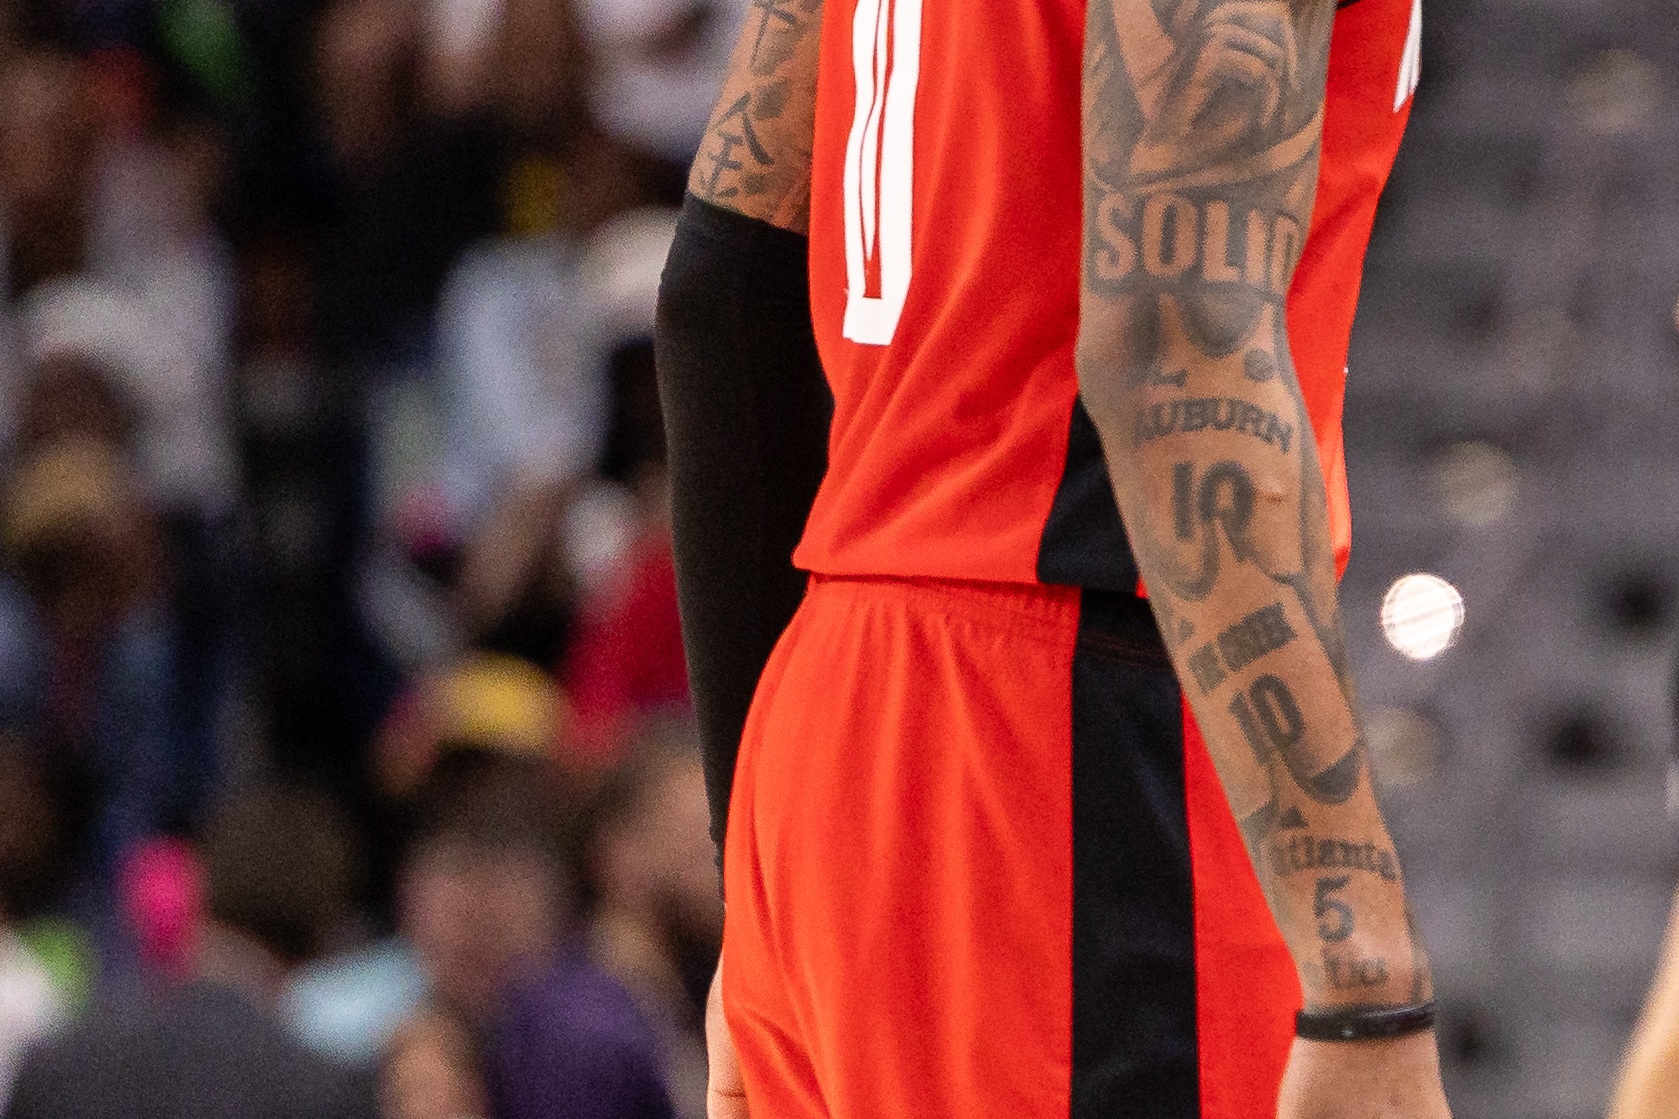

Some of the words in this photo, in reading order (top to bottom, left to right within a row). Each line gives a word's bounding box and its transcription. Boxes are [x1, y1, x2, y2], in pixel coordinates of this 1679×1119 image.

[1132, 397, 1294, 454] AUBURN
[1229, 674, 1305, 764] 10
[1313, 875, 1355, 942] 5
